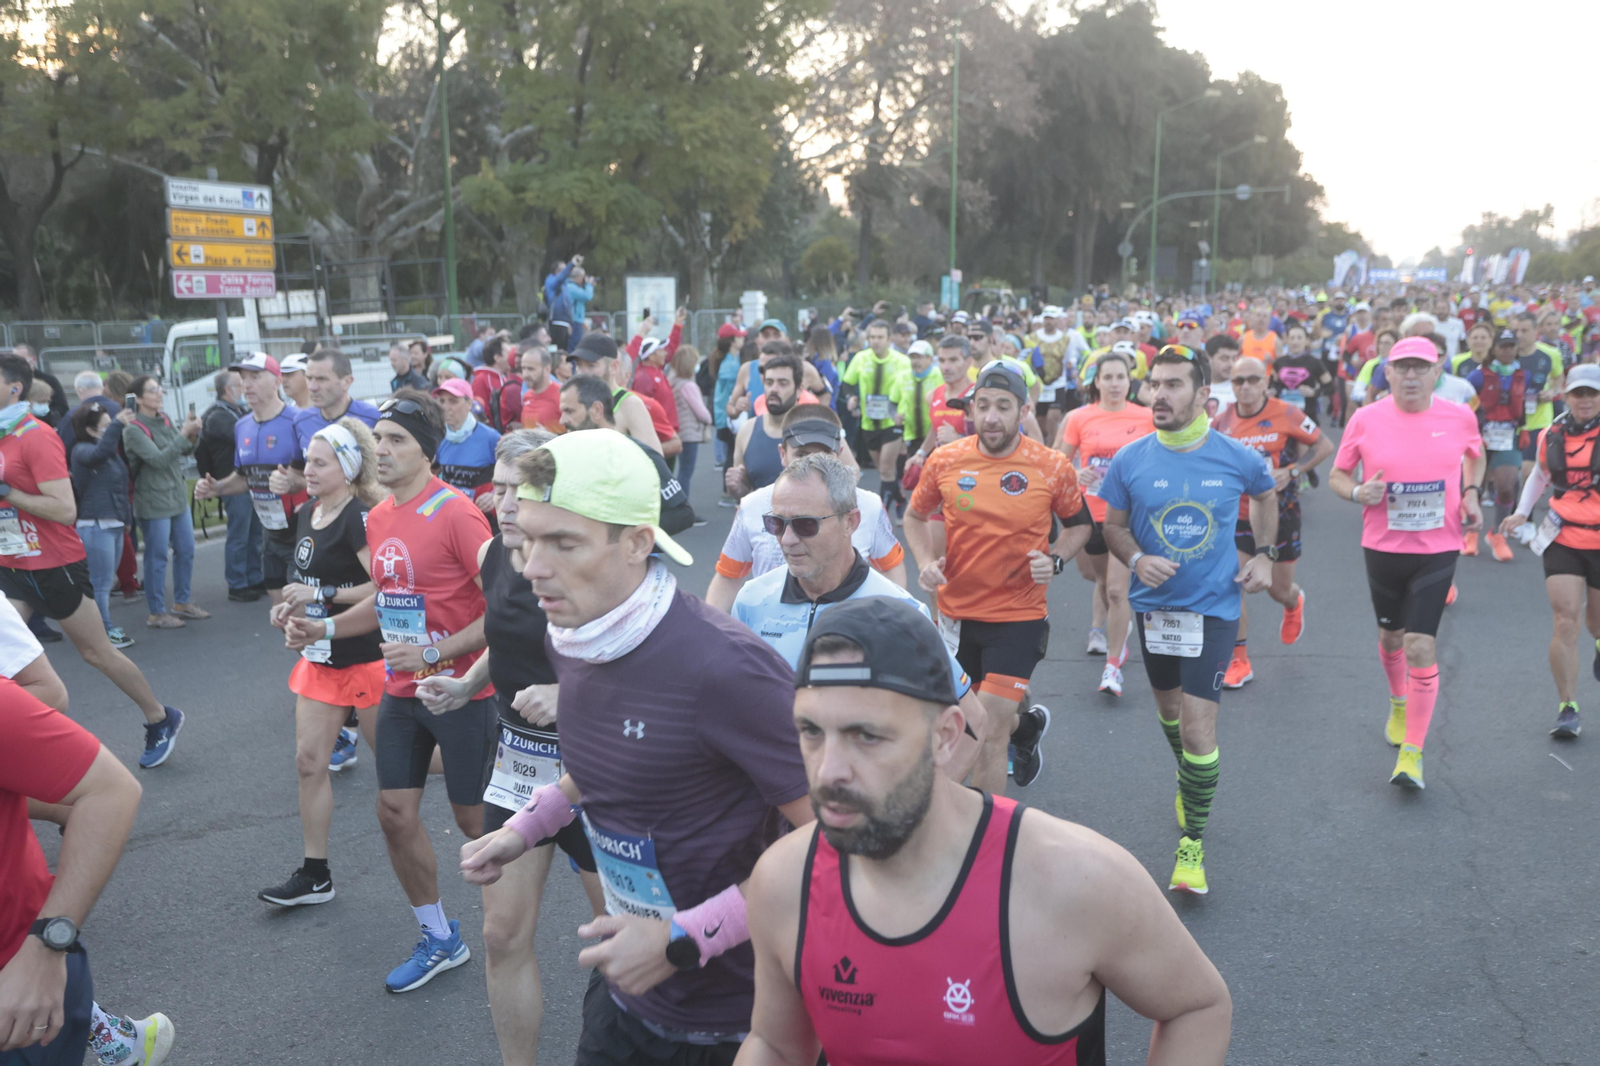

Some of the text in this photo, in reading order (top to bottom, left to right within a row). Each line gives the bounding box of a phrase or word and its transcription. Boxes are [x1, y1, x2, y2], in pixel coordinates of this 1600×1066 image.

[1405, 482, 1440, 493] ZURICH
[386, 597, 418, 607] ZURICH
[513, 735, 557, 754] ZURICH
[513, 761, 537, 778] 8029
[513, 782, 534, 796] JUAN
